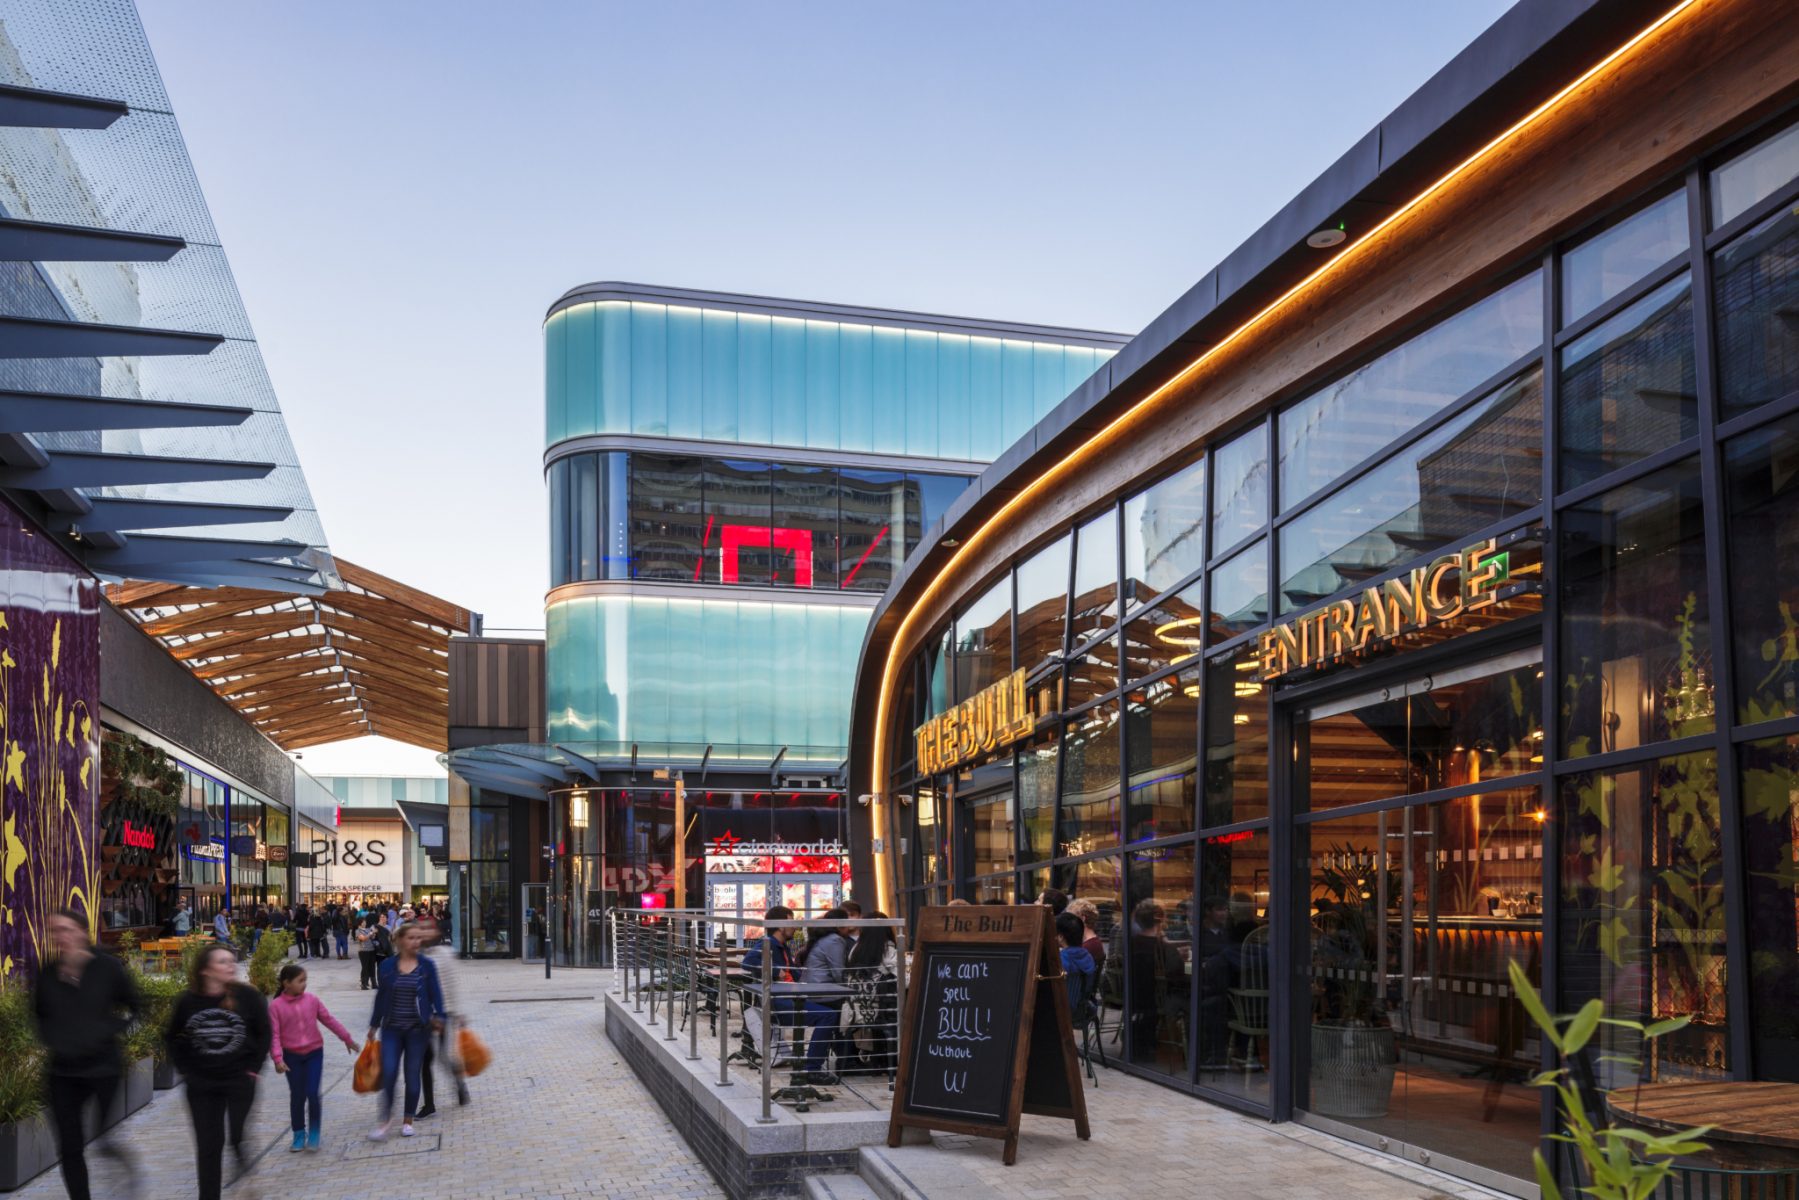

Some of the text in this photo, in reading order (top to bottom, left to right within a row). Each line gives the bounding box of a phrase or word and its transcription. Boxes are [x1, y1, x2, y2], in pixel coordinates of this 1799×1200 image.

[1257, 537, 1497, 680] ENTRANCE
[913, 666, 1035, 777] THE BULL
[123, 819, 155, 849] Nando's
[738, 838, 840, 855] cineworld
[942, 915, 1014, 933] The Bull
[958, 961, 989, 979] can't
[938, 1007, 991, 1037] BULL!
